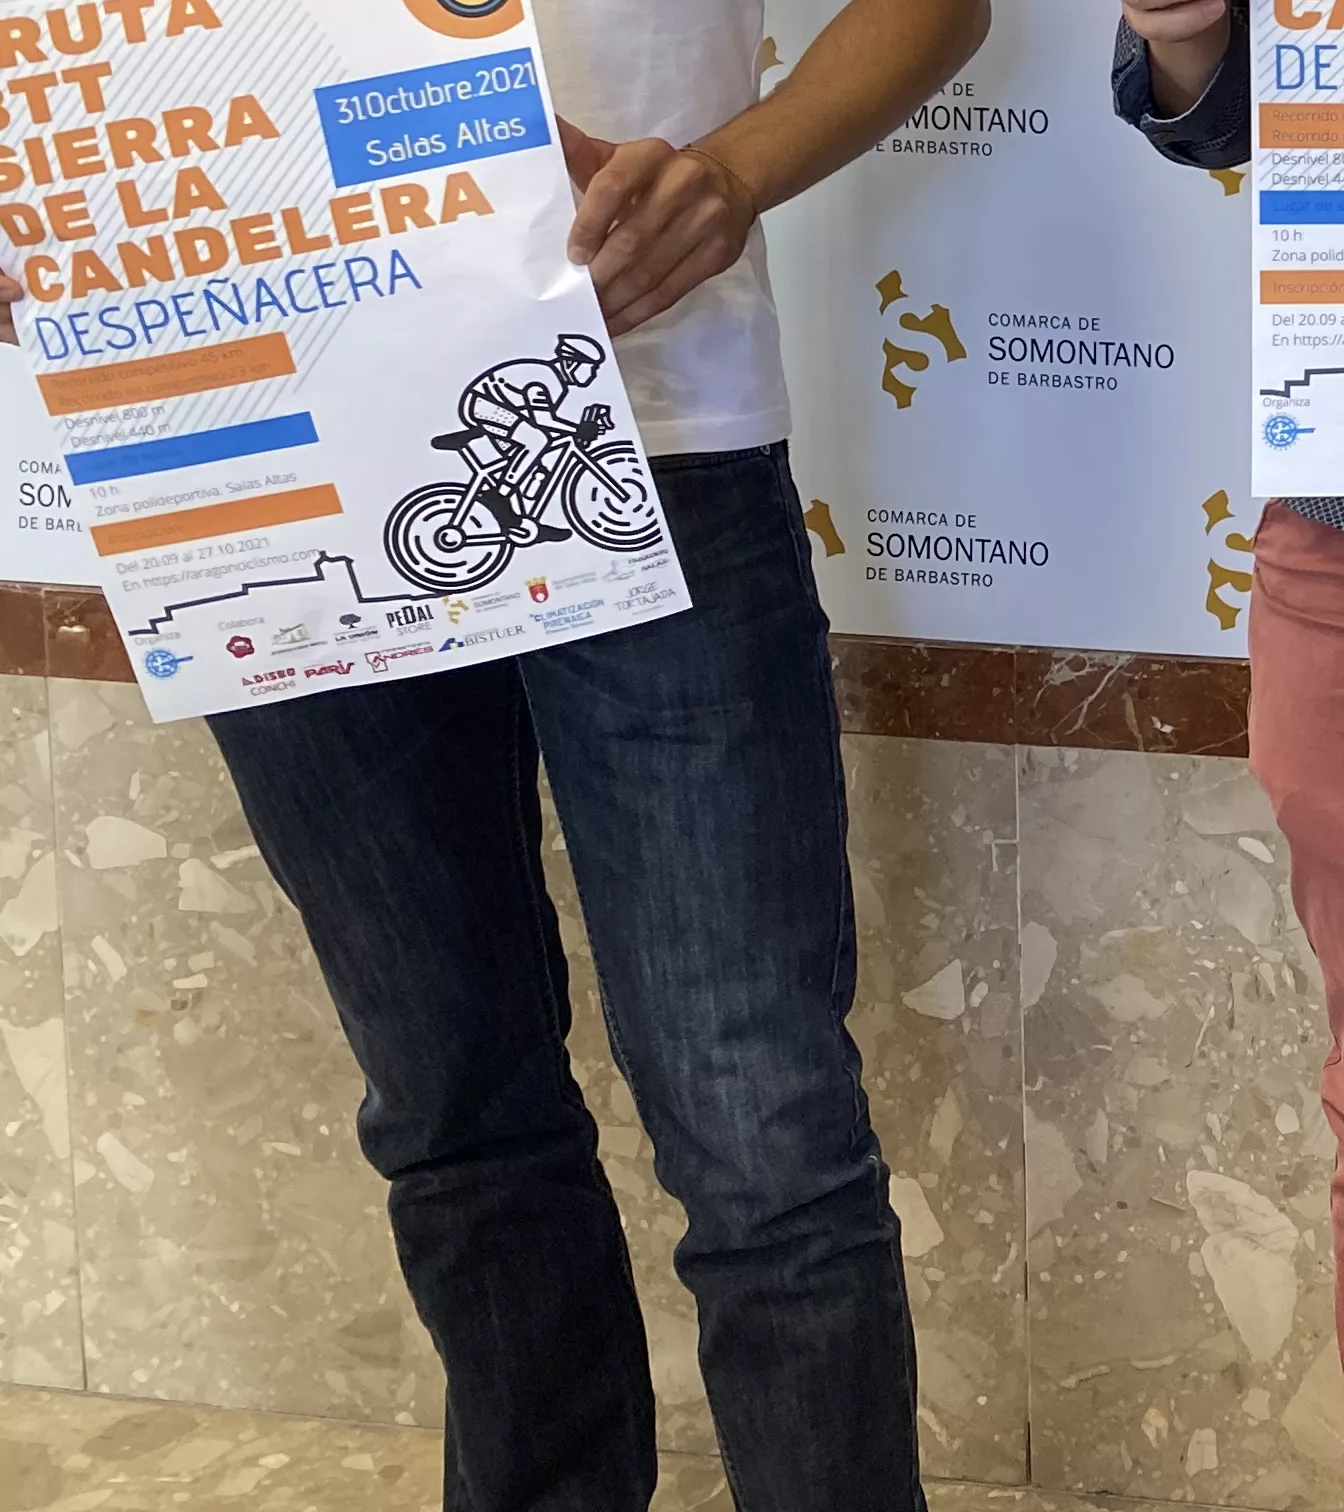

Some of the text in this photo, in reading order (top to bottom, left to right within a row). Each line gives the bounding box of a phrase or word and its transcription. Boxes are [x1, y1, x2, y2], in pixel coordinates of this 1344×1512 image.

[366, 118, 526, 166] Salas Altas
[1271, 153, 1329, 165] Desnivel
[1271, 173, 1329, 185] Desnivel
[0, 166, 228, 248] DE LA
[24, 171, 495, 303] CANDELERA
[1272, 229, 1302, 241] 10 h
[1272, 250, 1307, 261] Zona
[35, 248, 423, 360] DESPEÑACERA
[989, 313, 1100, 331] COMARCA DE
[1272, 313, 1294, 326] Del
[1298, 313, 1337, 325] 20.09
[1272, 335, 1289, 346] En
[989, 336, 1174, 368] SOMONTANO
[989, 372, 1117, 390] DE BARBASTRO
[1262, 397, 1310, 409] Organiza
[868, 509, 976, 528] COMARCA DE
[867, 532, 1048, 566] SOMONTANO
[866, 567, 992, 587] DE BARBASTRO
